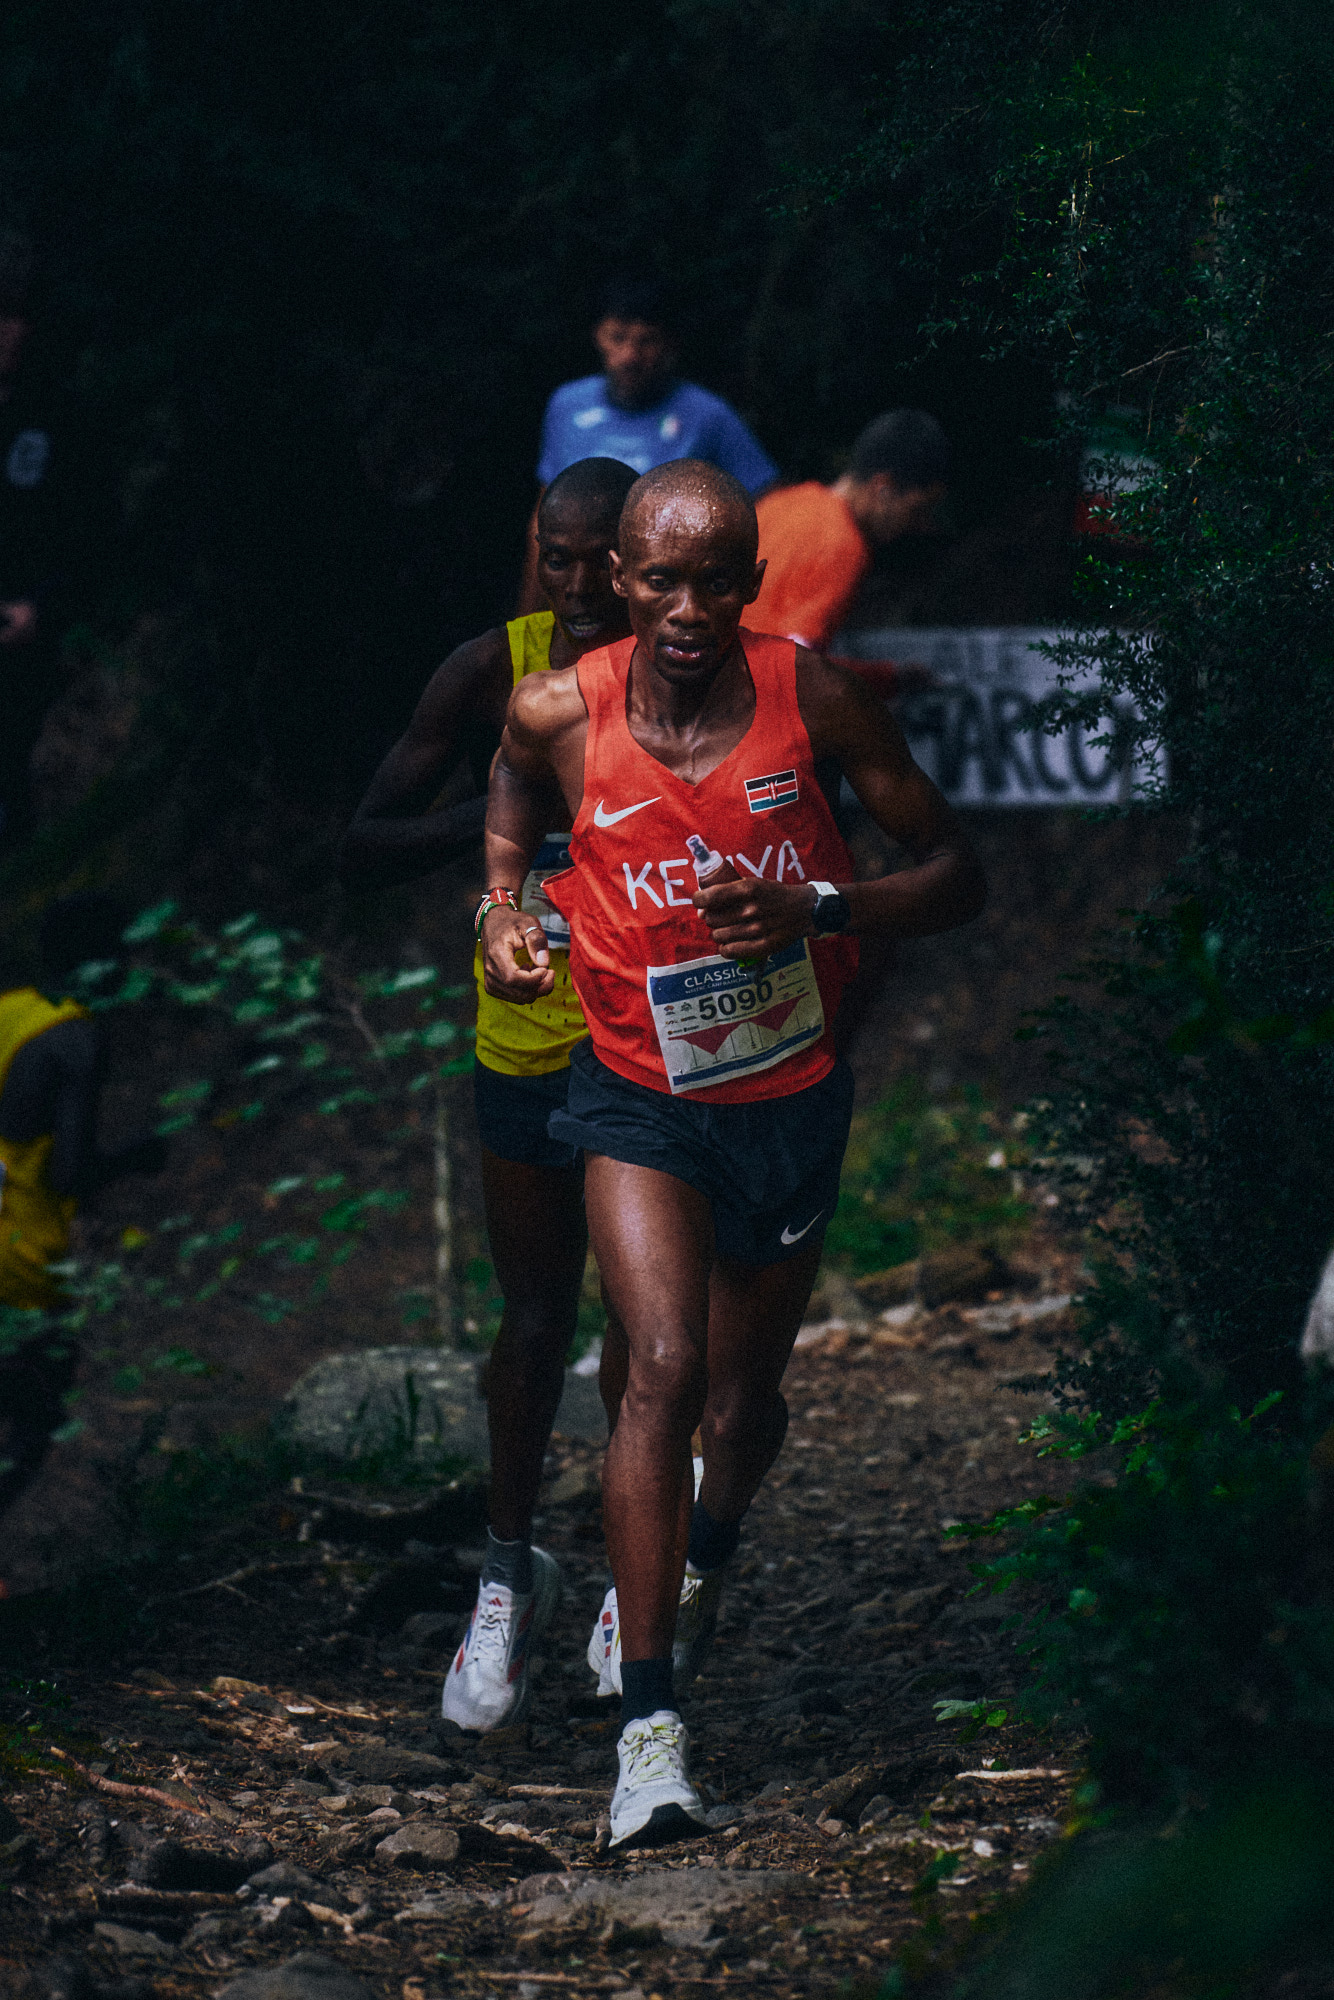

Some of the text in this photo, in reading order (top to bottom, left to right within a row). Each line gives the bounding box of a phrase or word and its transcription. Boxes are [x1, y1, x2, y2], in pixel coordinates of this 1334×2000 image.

[623, 840, 805, 910] KEYA
[684, 966, 747, 988] CLASSIC
[699, 981, 773, 1020] 5090
